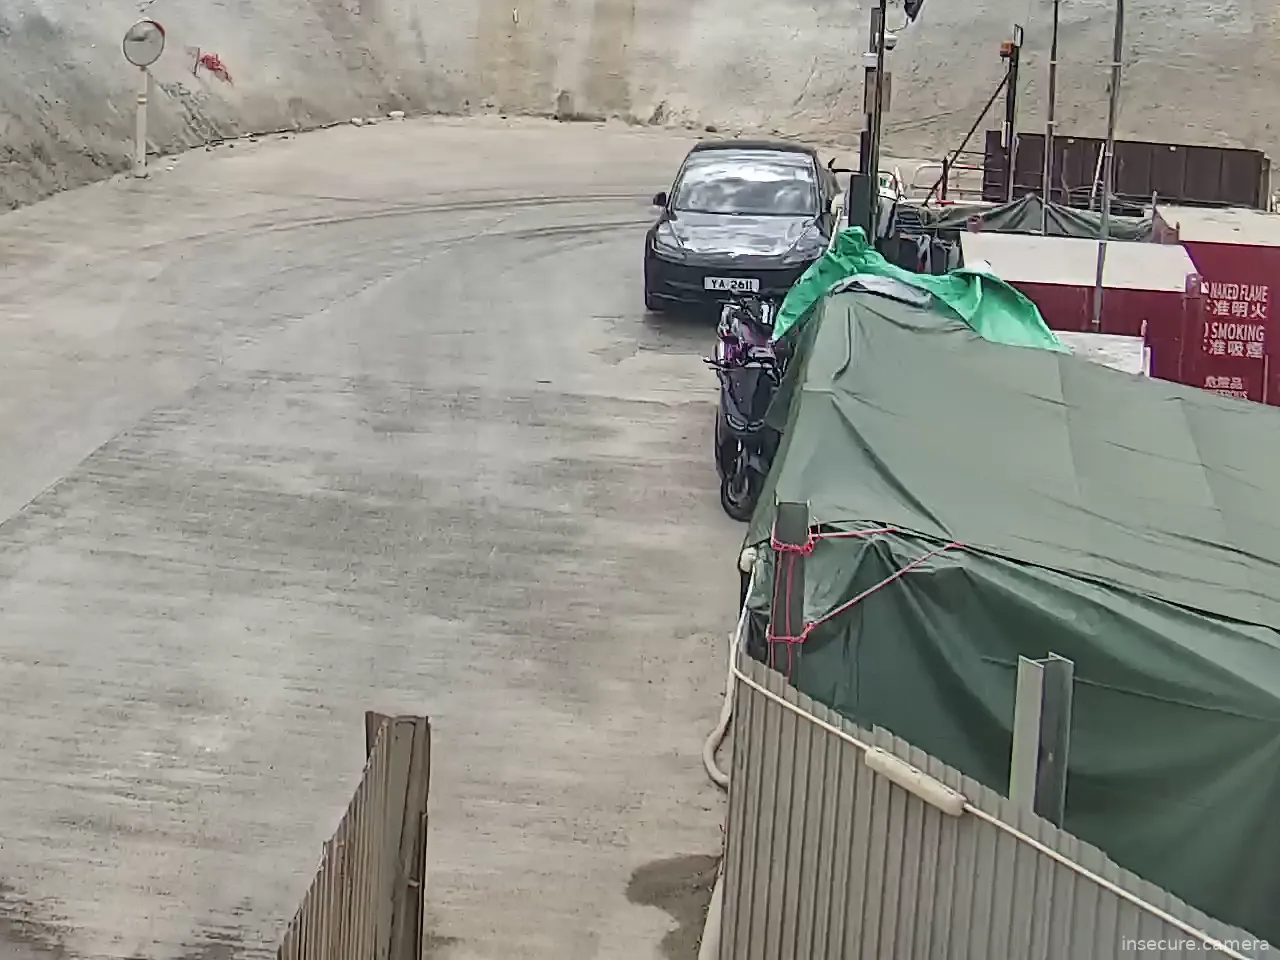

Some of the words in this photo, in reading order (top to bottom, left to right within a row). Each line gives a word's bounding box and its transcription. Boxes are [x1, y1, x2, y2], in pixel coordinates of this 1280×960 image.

[711, 279, 726, 289] YA
[1209, 282, 1239, 301] NAKED
[1240, 284, 1269, 303] FLAME
[1211, 321, 1265, 342] SMOKING
